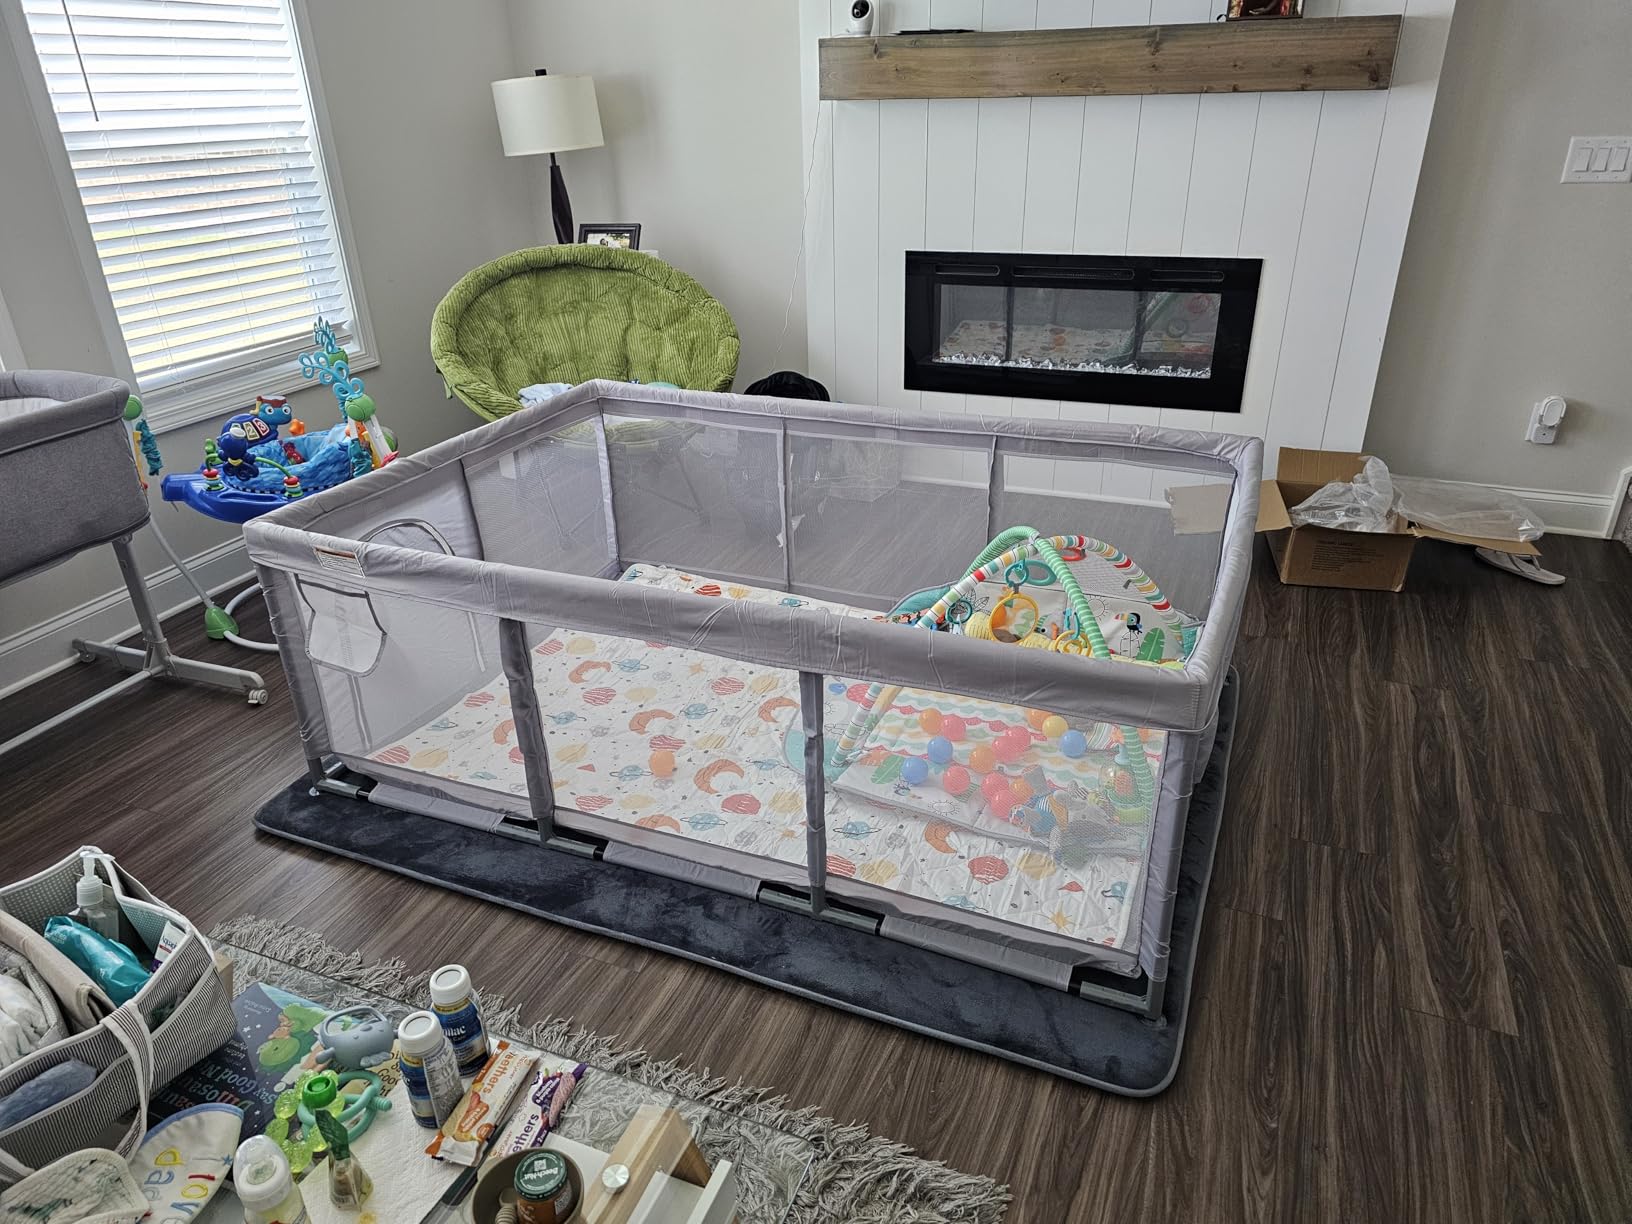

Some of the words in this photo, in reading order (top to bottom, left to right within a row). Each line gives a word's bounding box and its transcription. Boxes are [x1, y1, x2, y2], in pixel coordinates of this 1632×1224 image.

[219, 1067, 258, 1095] Good
[253, 1087, 278, 1105] Say
[512, 1113, 539, 1153] ethers
